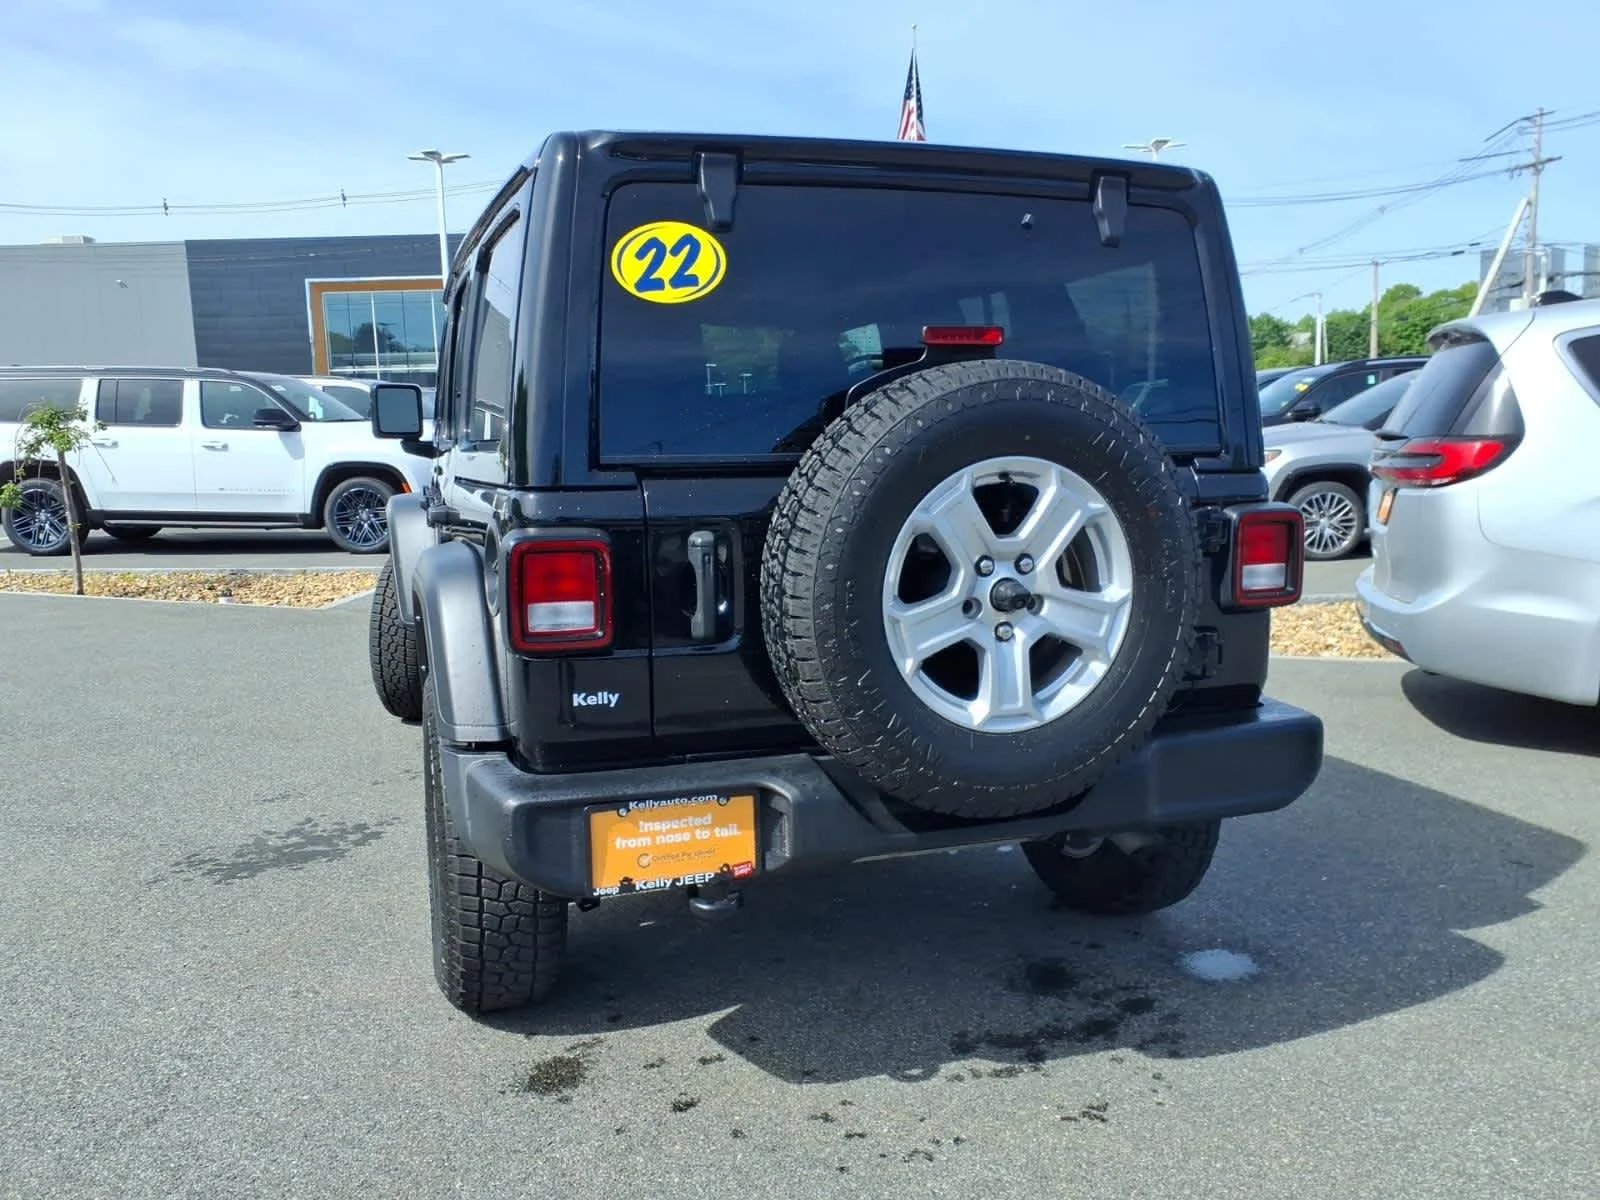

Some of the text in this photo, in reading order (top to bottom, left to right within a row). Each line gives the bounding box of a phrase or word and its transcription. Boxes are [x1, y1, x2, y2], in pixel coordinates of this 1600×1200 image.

[634, 233, 701, 293] 22
[572, 691, 620, 708] Kelly
[629, 794, 718, 810] Kellyauto.com
[639, 813, 713, 833] Inspected
[615, 824, 742, 849] from nose to tail.
[635, 872, 715, 891] Kelly JEEP
[593, 886, 620, 897] Jeep
